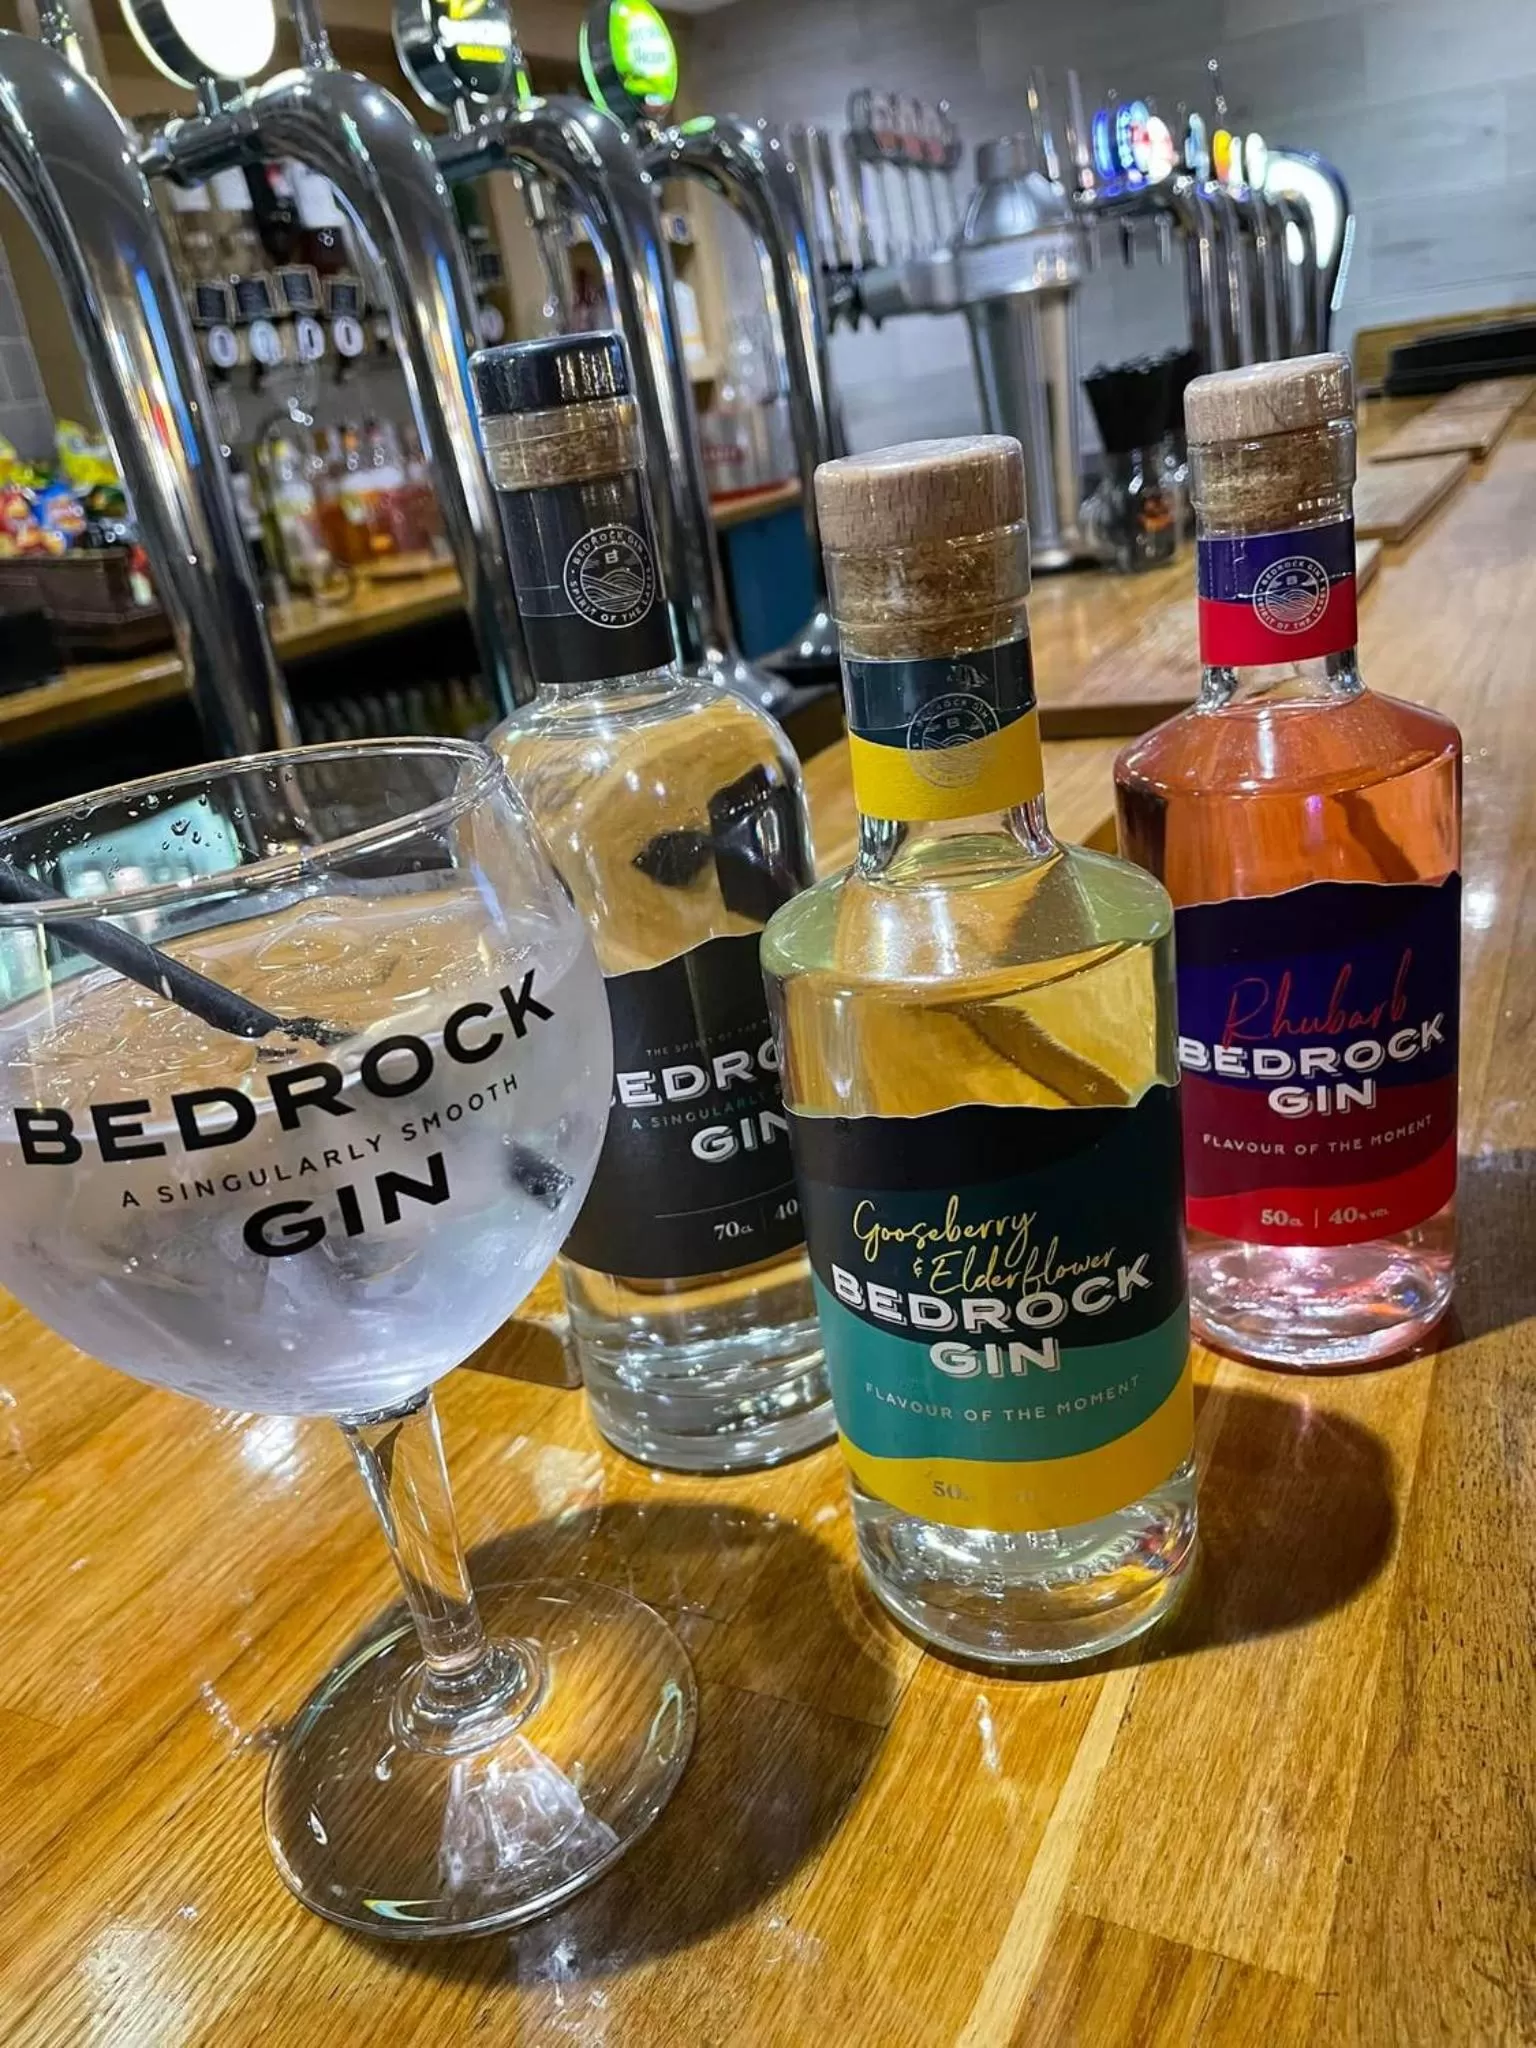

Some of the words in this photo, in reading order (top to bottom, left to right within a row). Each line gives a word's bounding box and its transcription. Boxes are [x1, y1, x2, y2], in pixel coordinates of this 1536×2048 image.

[569, 580, 597, 616] SPIRIT
[600, 613, 617, 623] OF
[622, 607, 642, 622] THE
[1257, 596, 1275, 625] IRIT
[1221, 948, 1412, 1051] Rhubarb
[14, 968, 555, 1166] BEDROCK
[674, 1036, 713, 1053] SPIT
[1178, 1012, 1446, 1080] BEDROCK
[631, 1118, 644, 1131] A
[1268, 1078, 1377, 1119] GIN
[121, 1189, 142, 1209] A
[158, 1133, 385, 1205] SINGULARLY
[401, 1073, 520, 1142] SMOOTH
[1203, 1133, 1286, 1155] FLAVOUR
[1294, 1143, 1319, 1156] OF
[1328, 1138, 1363, 1153] THE
[1370, 1114, 1433, 1147] MOMENT
[243, 1151, 451, 1258] GIN
[852, 1194, 1038, 1268] Gooseberry
[830, 1253, 1154, 1335] BEDROCK
[928, 1236, 1117, 1298] Elderflower
[929, 1337, 1061, 1380] GIN
[865, 1381, 953, 1420] FLAVOUR
[964, 1410, 993, 1422] OF
[1003, 1408, 1048, 1421] THE
[1057, 1374, 1140, 1417] MOMENT
